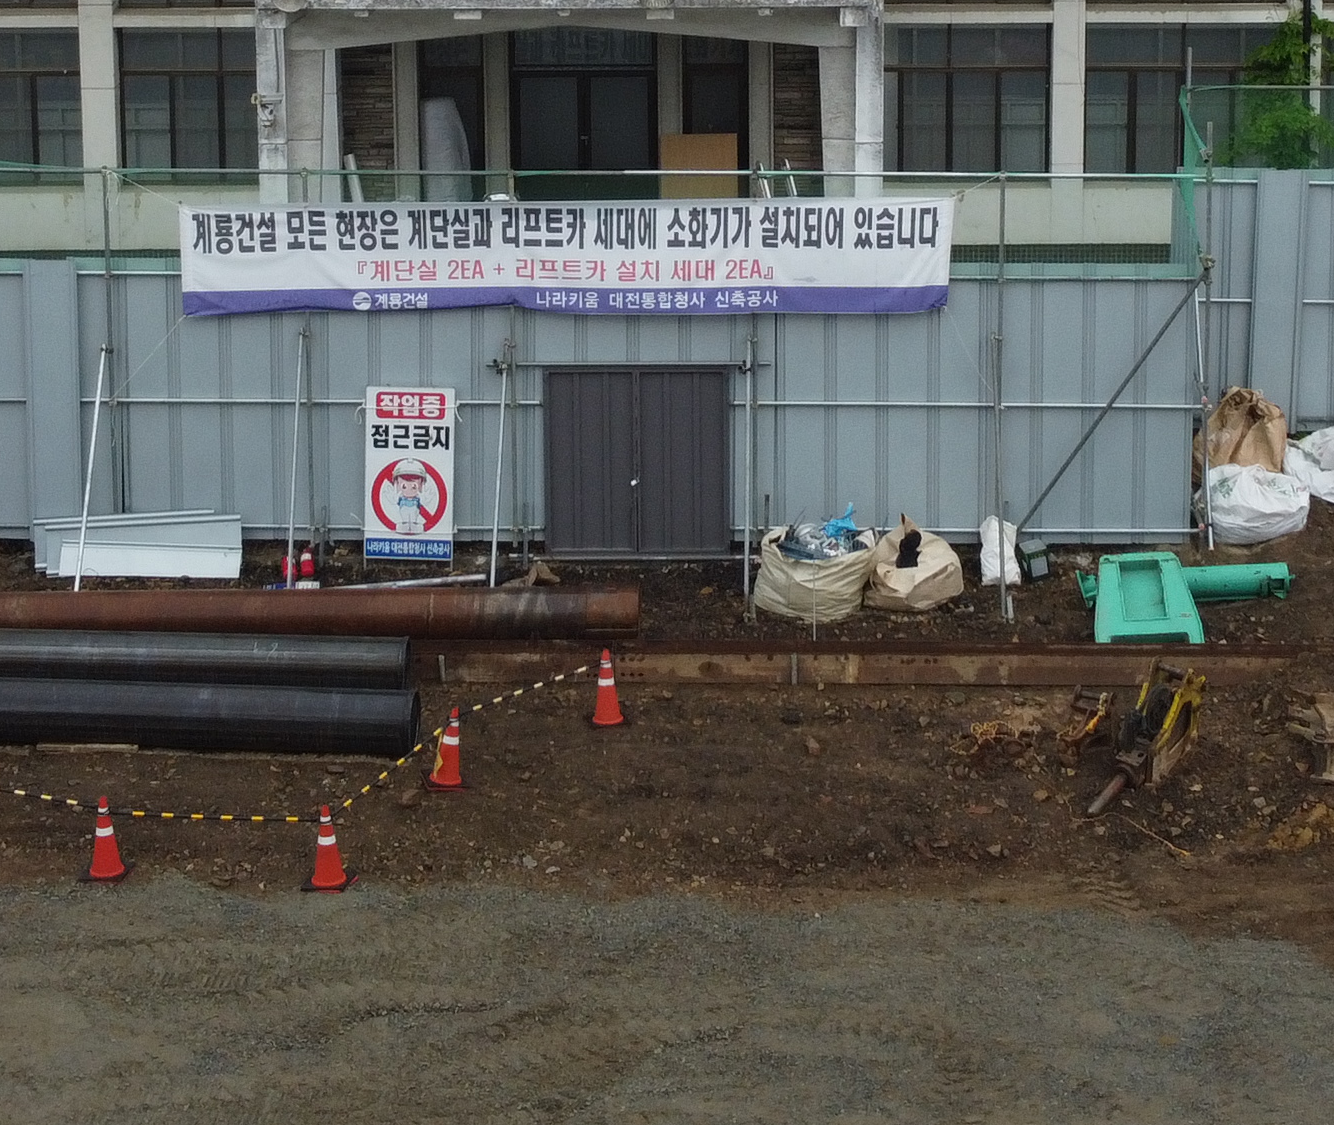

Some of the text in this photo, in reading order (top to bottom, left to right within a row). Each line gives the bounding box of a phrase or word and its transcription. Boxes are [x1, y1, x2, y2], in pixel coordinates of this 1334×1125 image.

[192, 206, 939, 254] 계룡건설 모든 현장은 계단실과 리프트카 세대에 소화기가 설치되어 있습니다
[448, 260, 485, 281] 2EA
[515, 259, 607, 282] 리프트카
[616, 259, 661, 282] 설치
[671, 259, 716, 282] 세대
[374, 292, 429, 309] 계룡건설
[536, 290, 779, 309] 나라키움 대전통합청사 신축공사
[380, 394, 441, 417] 작업중
[371, 424, 450, 451] 접근금지
